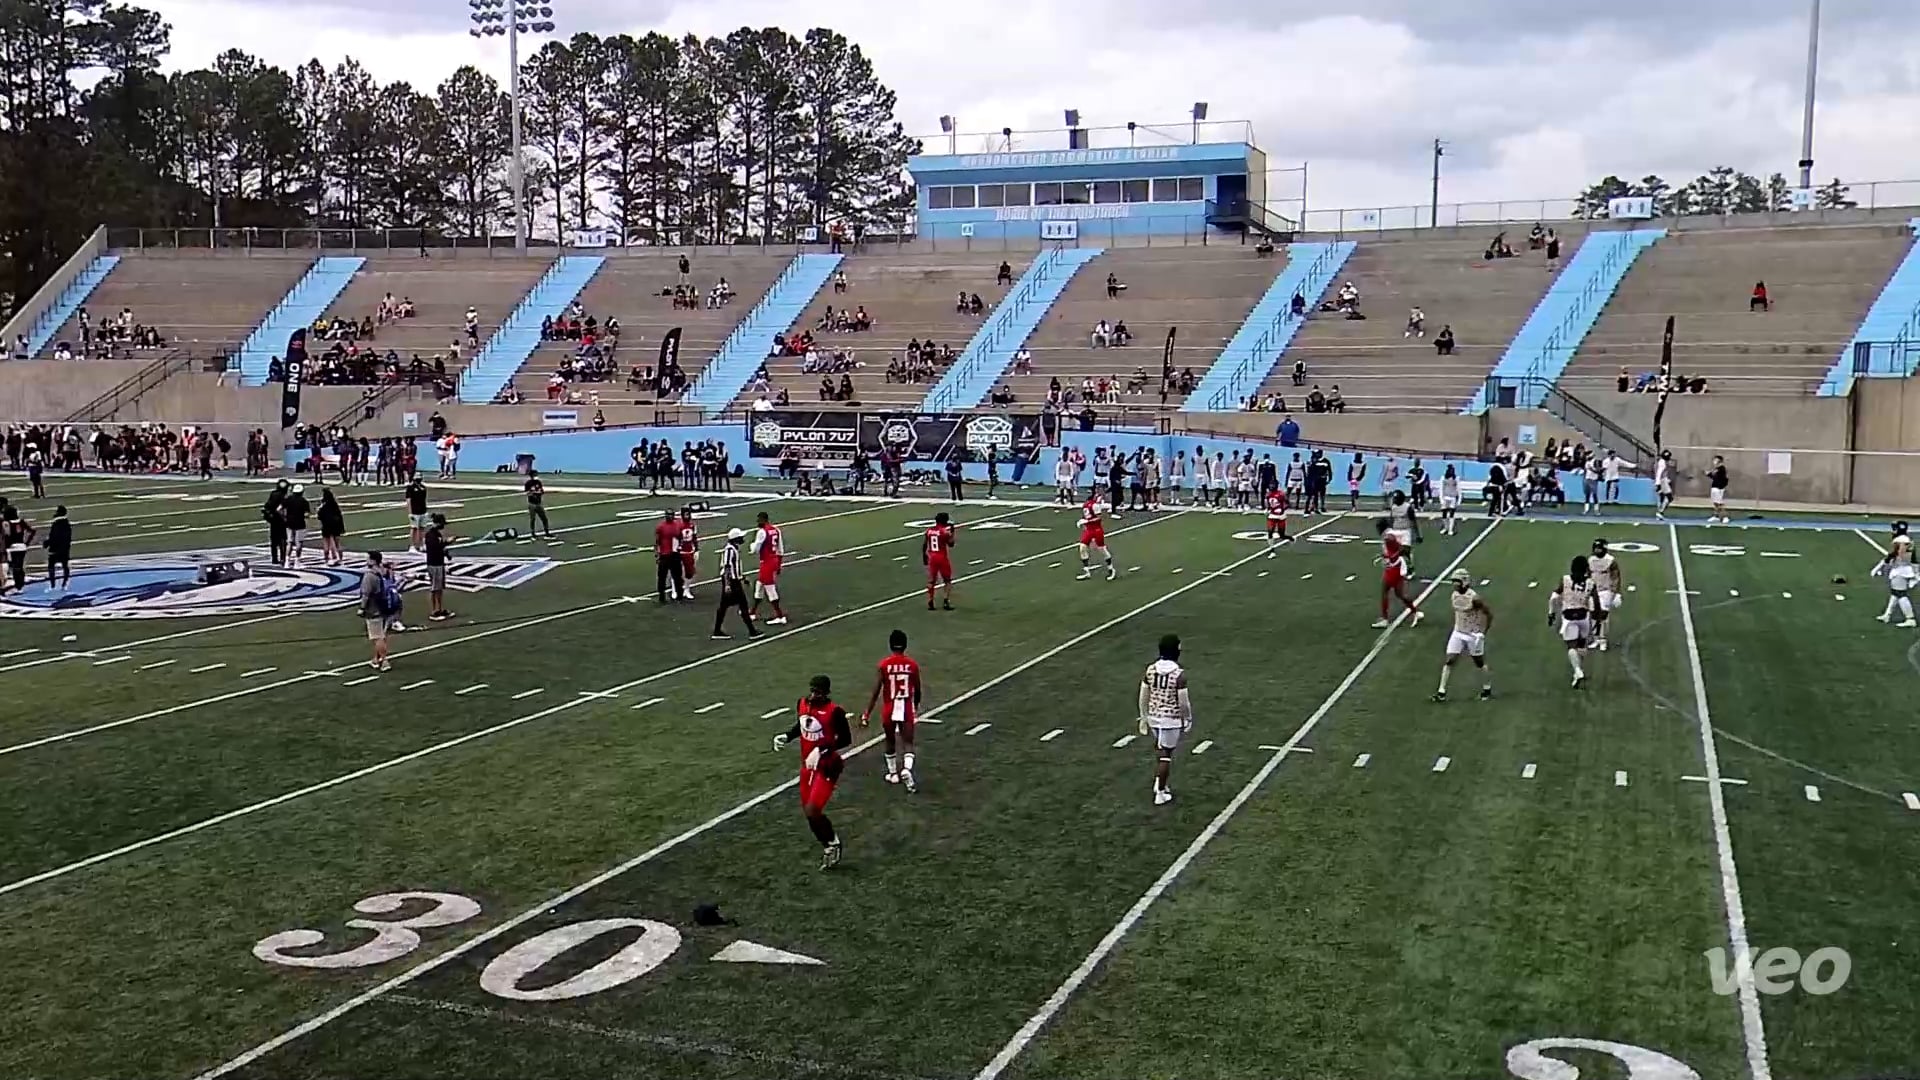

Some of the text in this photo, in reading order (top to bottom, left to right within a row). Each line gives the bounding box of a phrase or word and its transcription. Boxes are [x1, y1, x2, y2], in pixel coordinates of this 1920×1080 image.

[287, 362, 300, 393] ONE
[783, 431, 826, 441] PYLON
[969, 434, 1008, 443] PYLON
[888, 674, 910, 699] 13
[1153, 672, 1169, 690] 10
[252, 890, 682, 1001] 30
